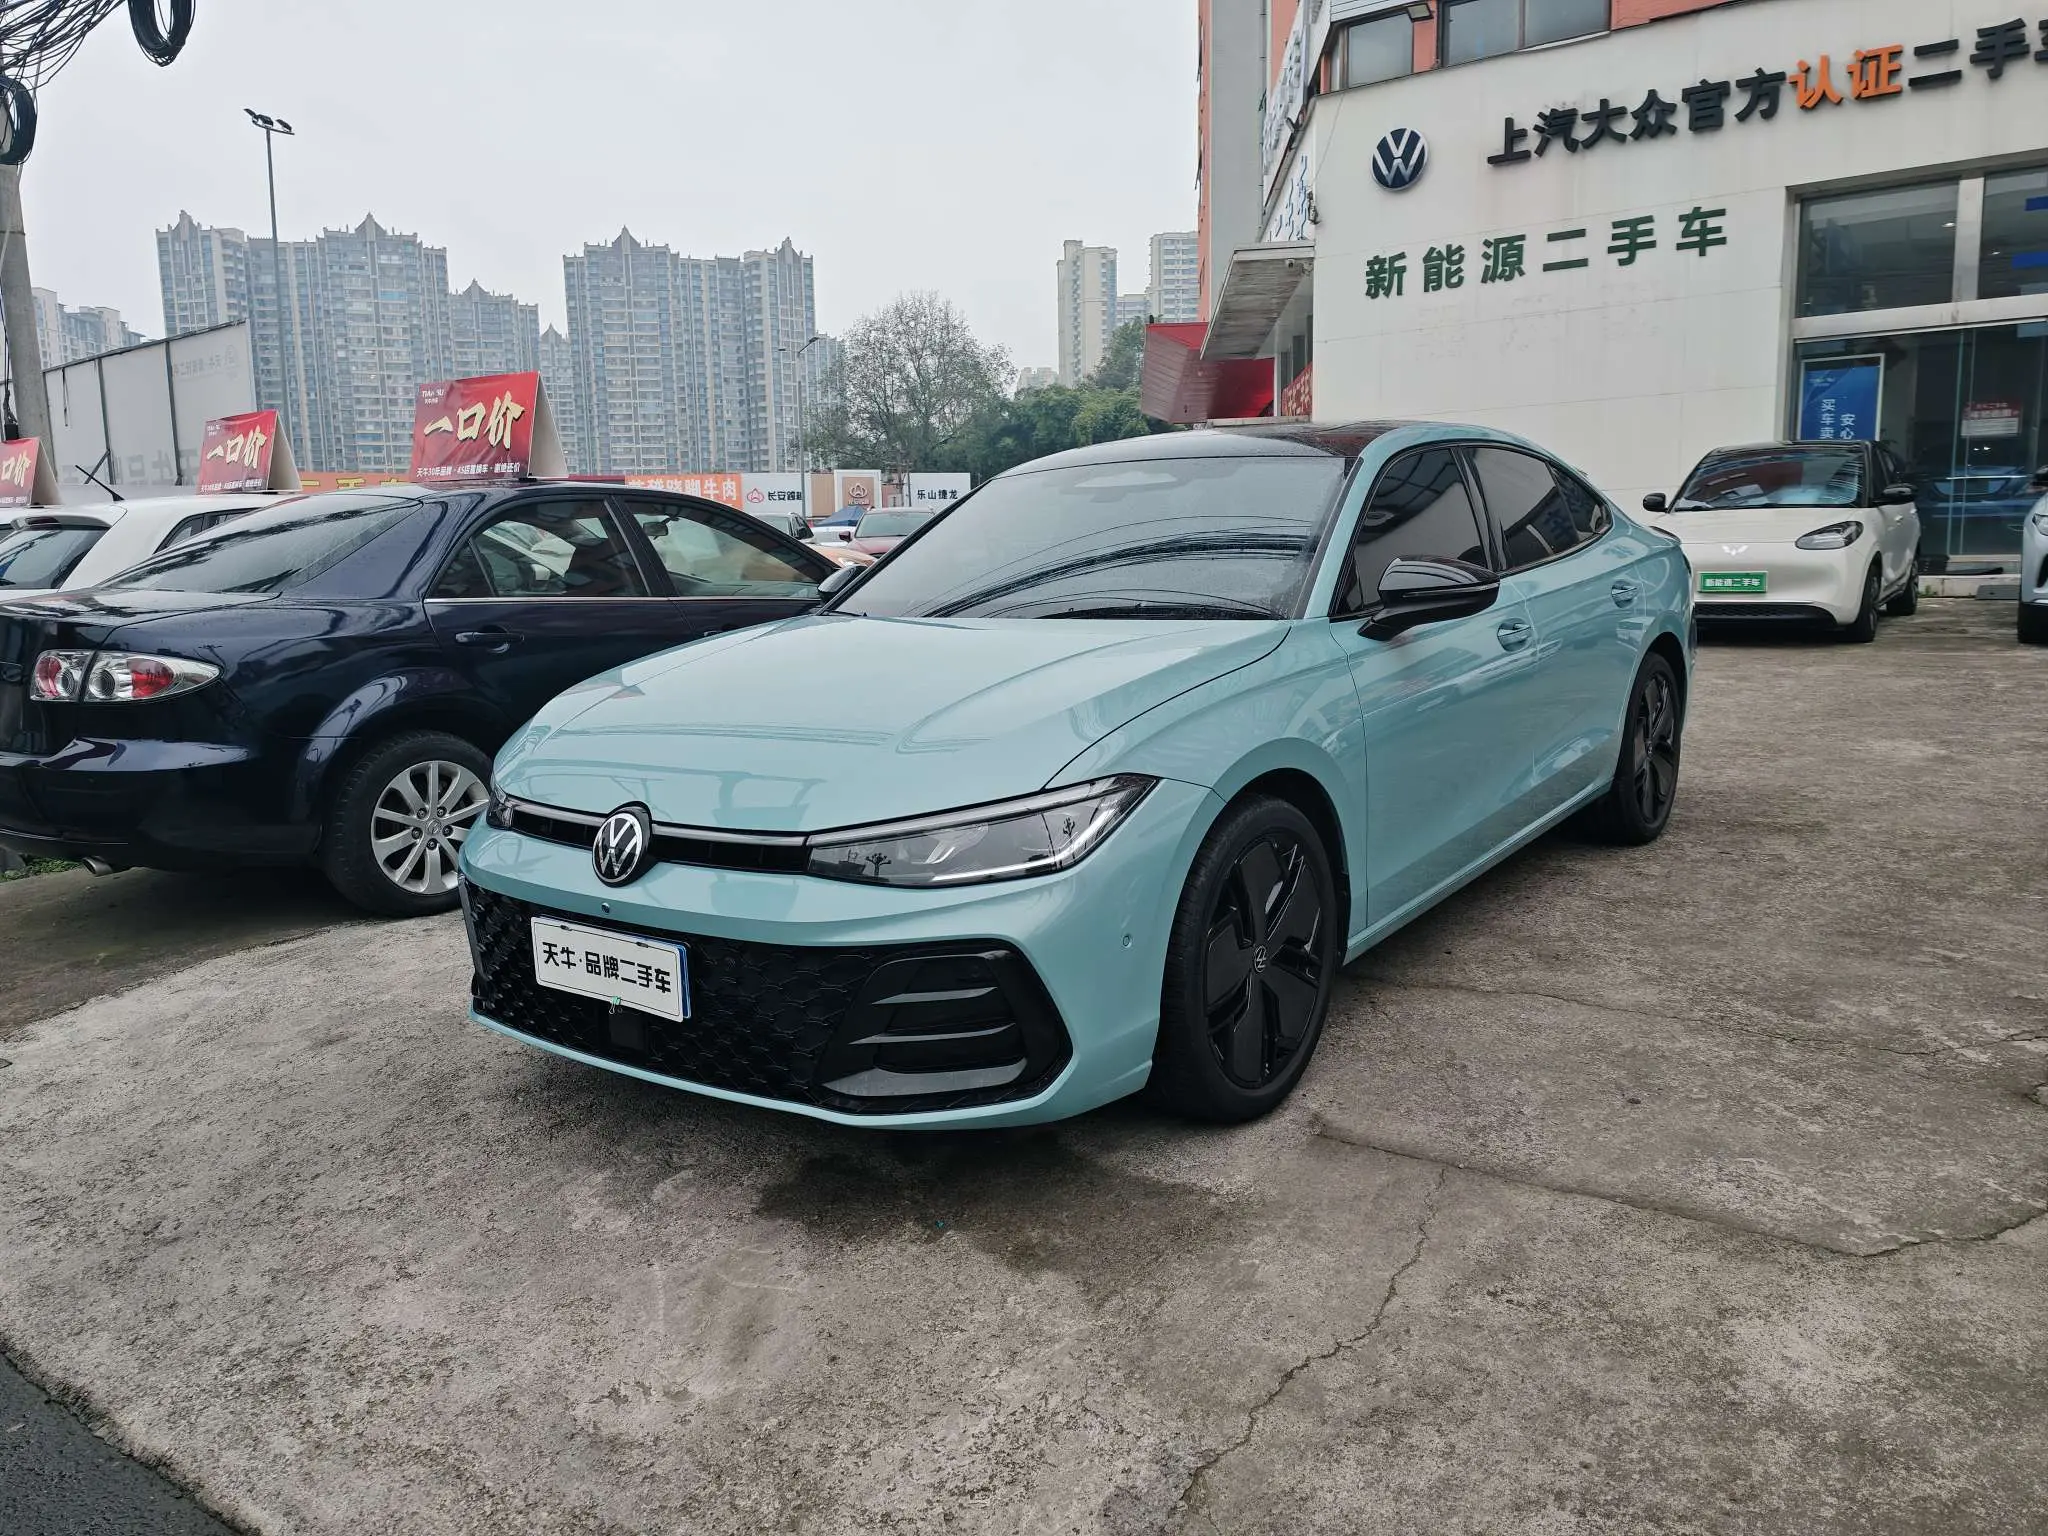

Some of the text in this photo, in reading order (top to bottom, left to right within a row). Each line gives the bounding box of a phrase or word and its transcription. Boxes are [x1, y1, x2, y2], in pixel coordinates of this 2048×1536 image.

[1487, 17, 2048, 166] 上汽大众官方认证二手
[1365, 207, 1727, 300] 新能源二手车
[206, 425, 267, 469] 一口价
[424, 390, 525, 450] 一口价
[917, 489, 958, 500] 乐山捷龙
[542, 941, 671, 994] 天牛·品牌二手车
